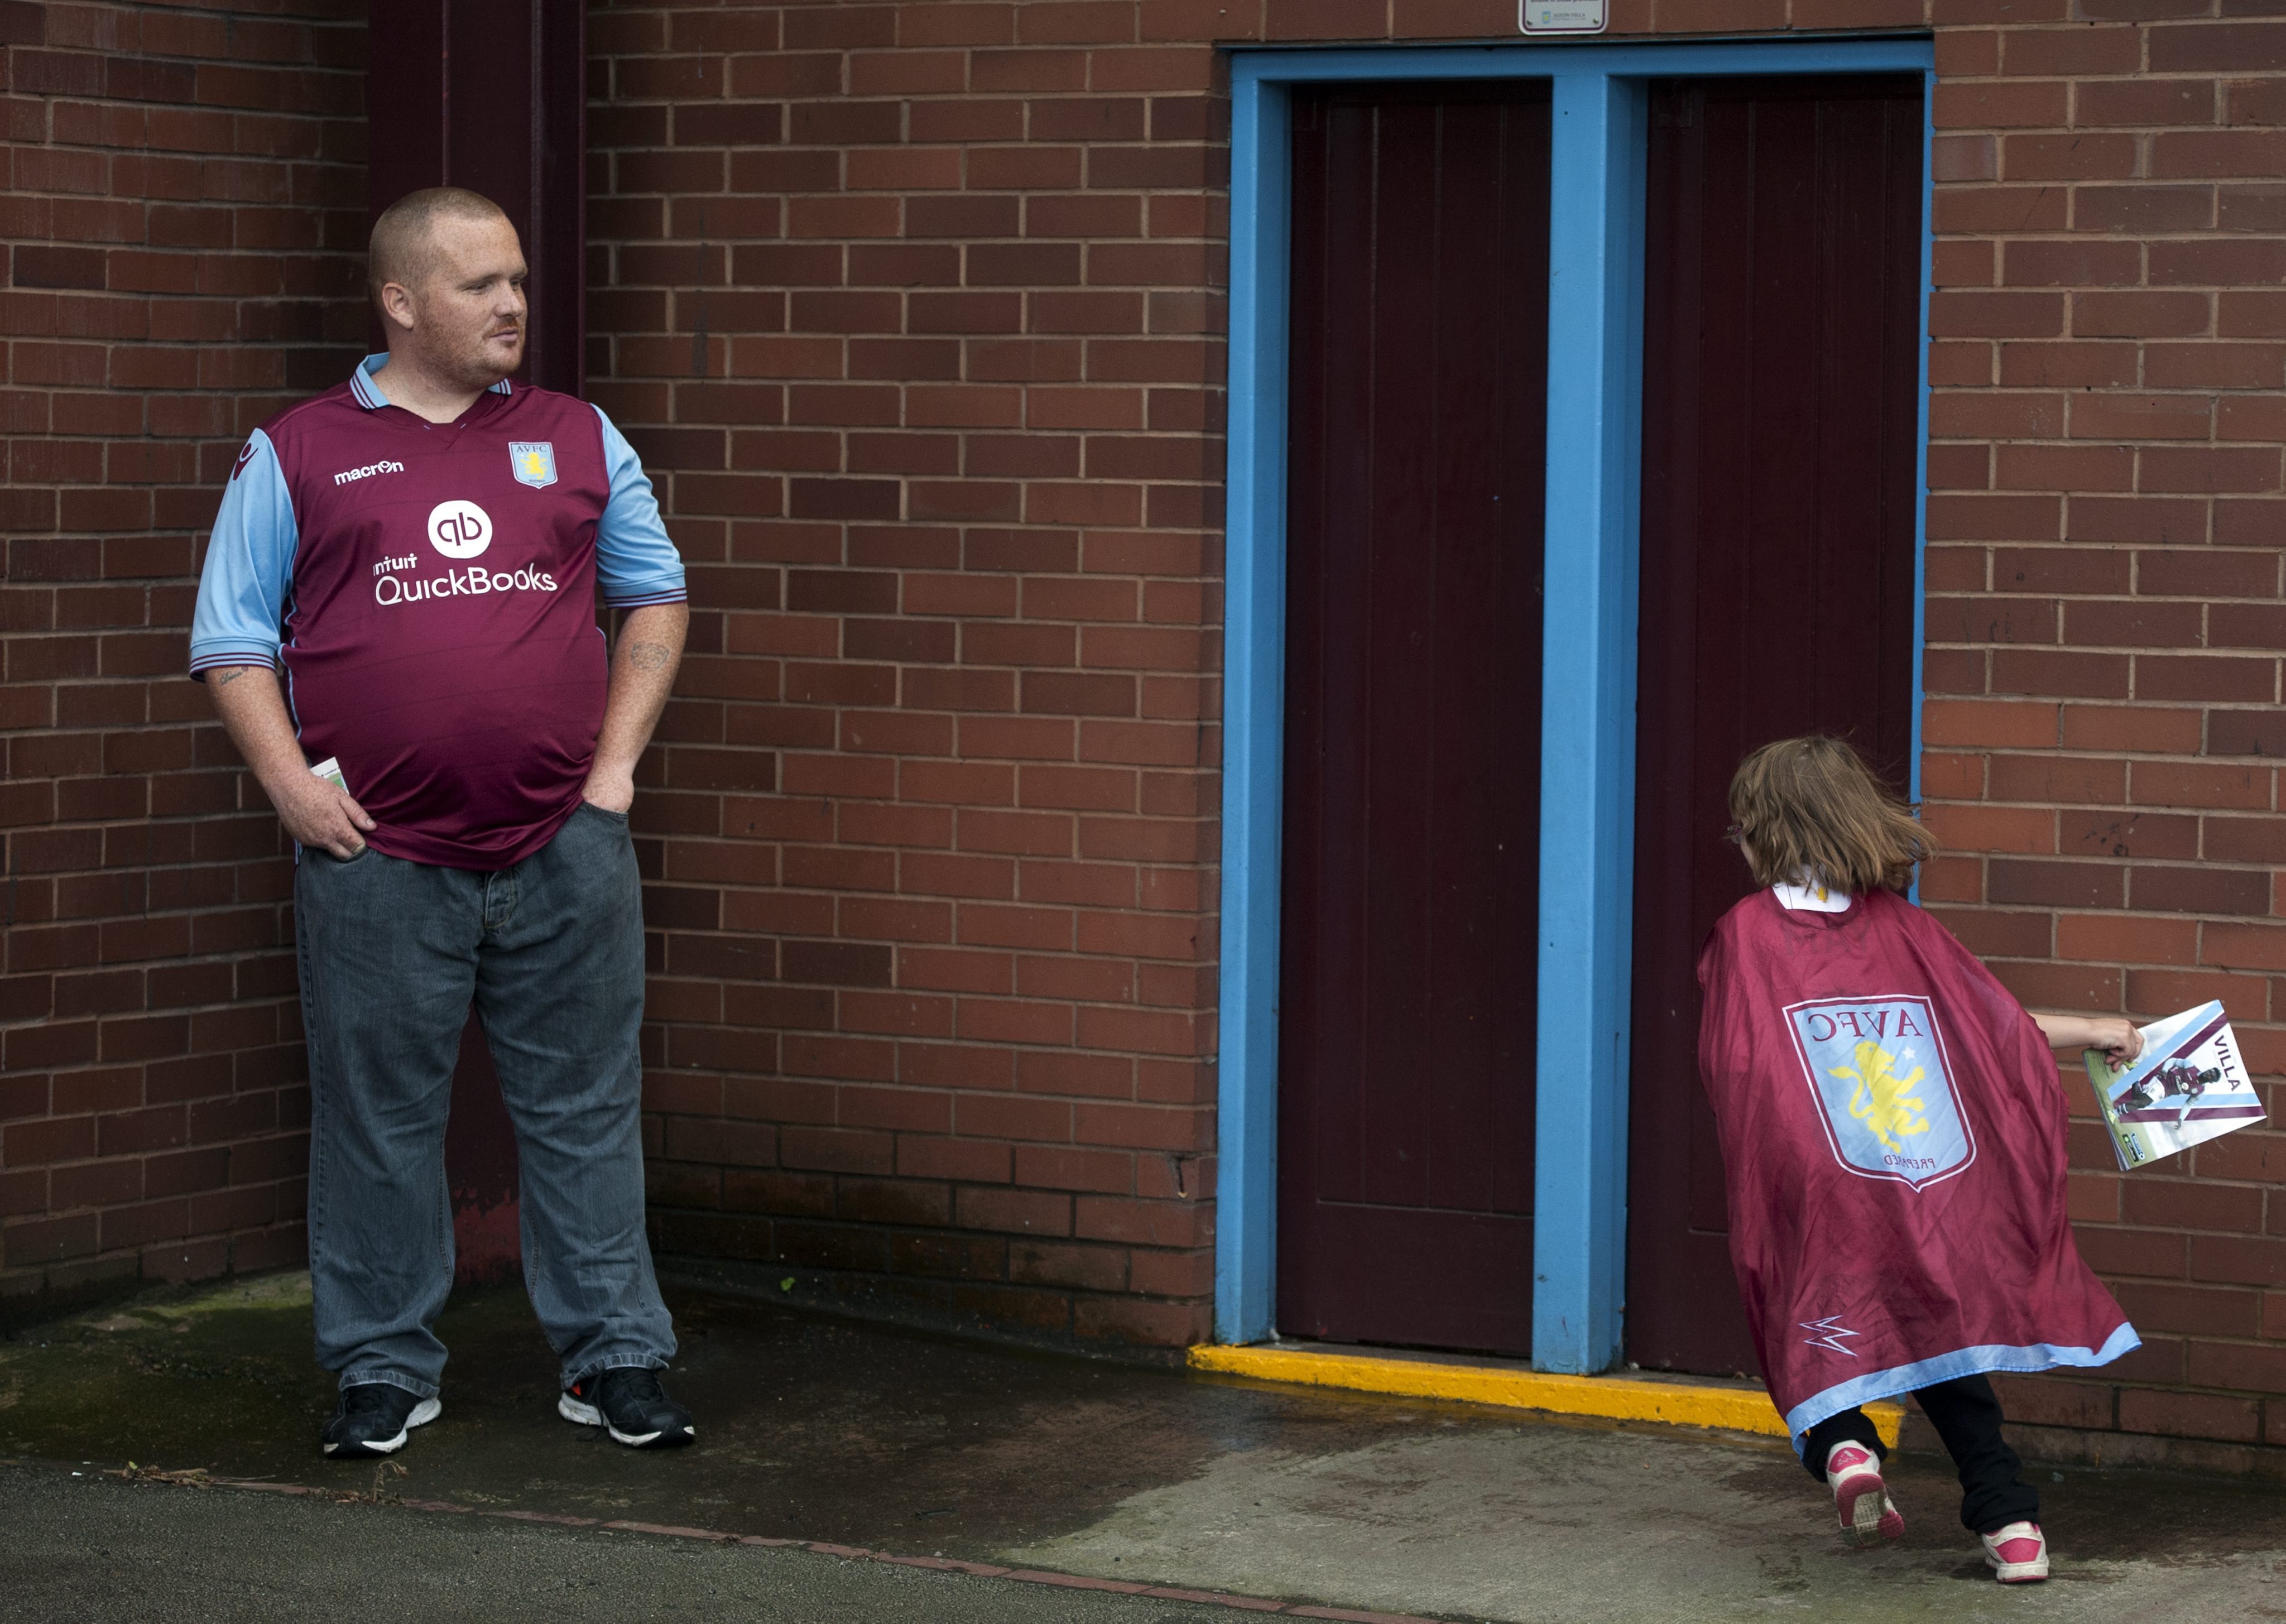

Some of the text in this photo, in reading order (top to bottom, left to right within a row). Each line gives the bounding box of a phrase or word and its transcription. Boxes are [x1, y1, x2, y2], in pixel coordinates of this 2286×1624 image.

[334, 460, 404, 485] macron
[375, 562, 558, 606] QuickBooks
[2214, 1035, 2241, 1092] VILLA
